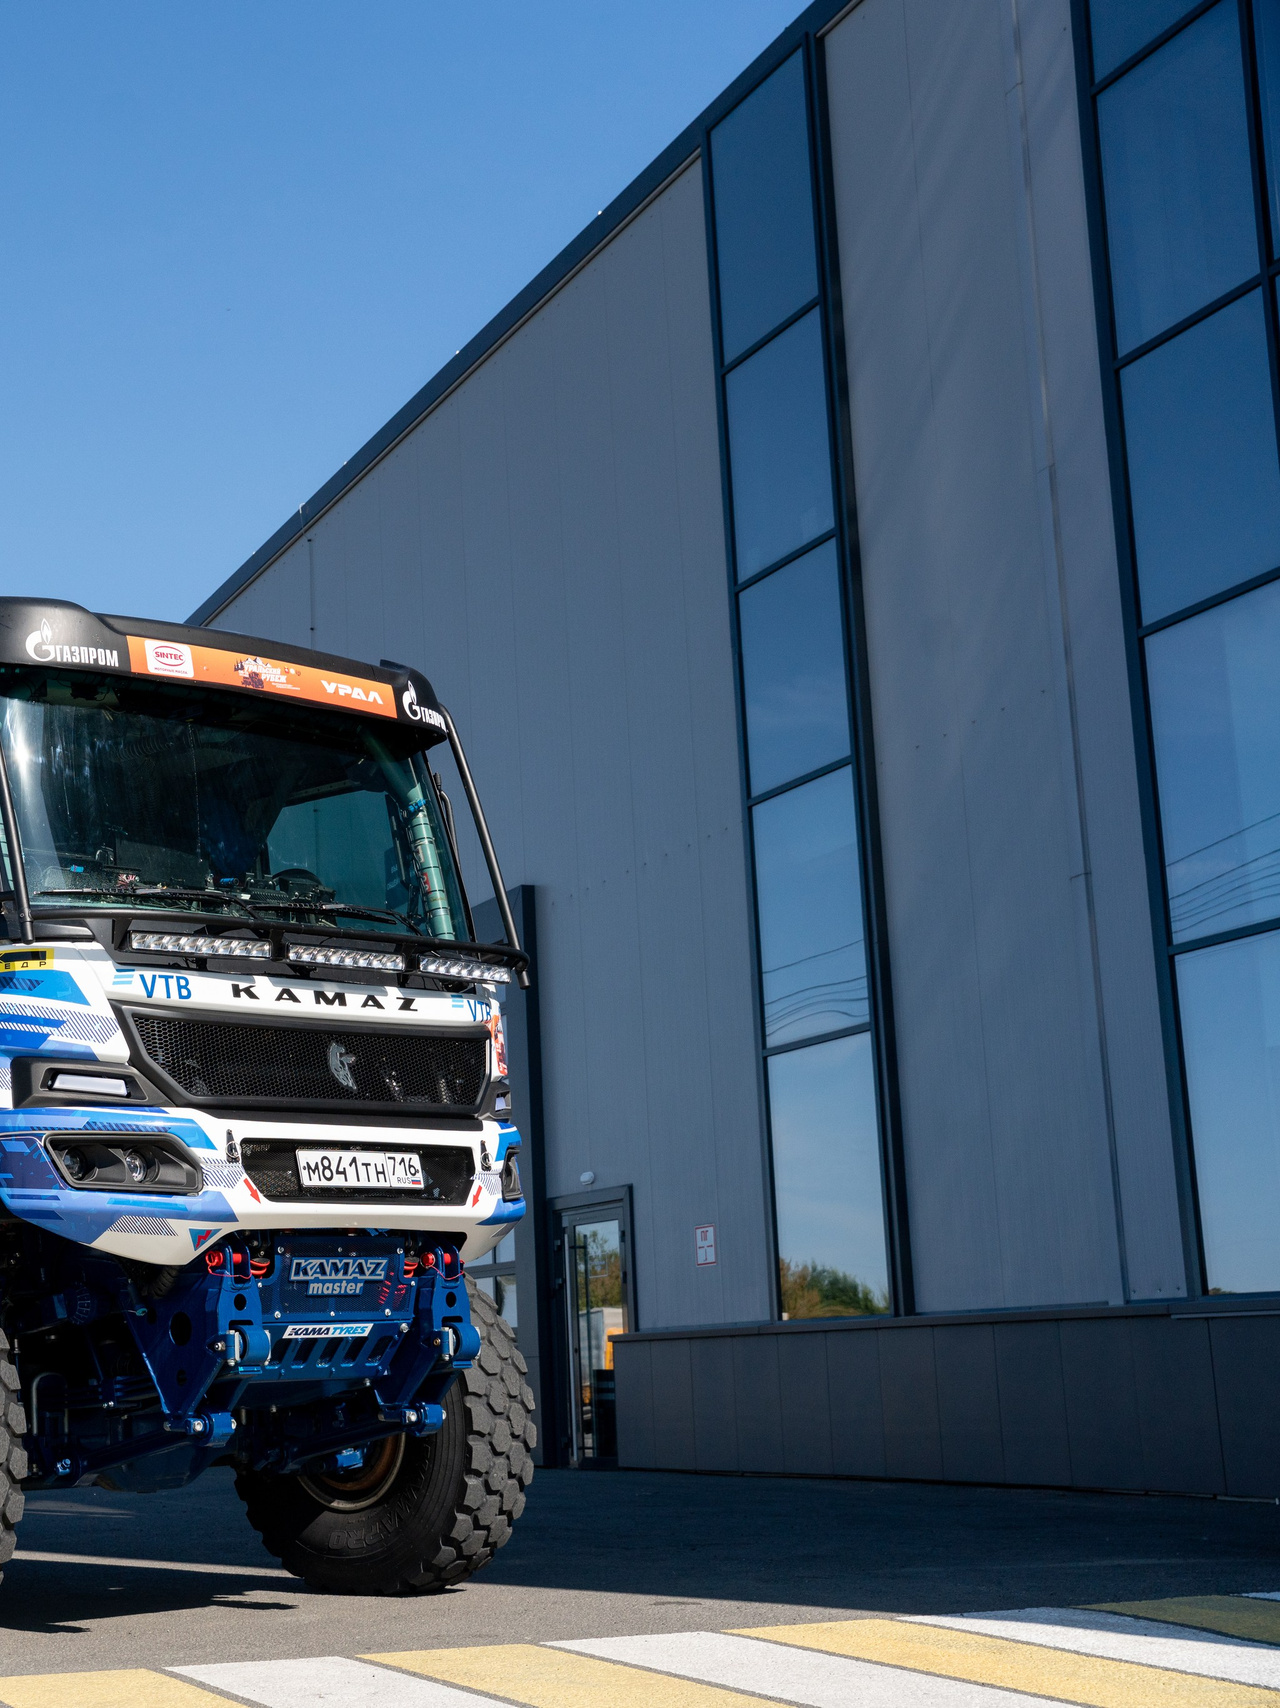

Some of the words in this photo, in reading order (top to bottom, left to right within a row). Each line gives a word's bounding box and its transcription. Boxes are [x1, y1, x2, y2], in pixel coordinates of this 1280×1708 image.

[55, 645, 119, 667] ГАЗПРОМ
[155, 650, 184, 662] SINTEC
[244, 663, 281, 675] УРАЛЬСКИЙ
[261, 673, 287, 683] РУБЕЖ
[320, 680, 384, 705] УРАЛ
[139, 974, 192, 1000] VTB
[231, 983, 418, 1012] KAMAZ
[305, 1155, 388, 1183] М841ТН
[387, 1156, 418, 1177] 716
[396, 1176, 412, 1185] RUS
[290, 1259, 389, 1280] KAMAZ
[308, 1280, 364, 1295] master
[288, 1326, 331, 1336] KAMA
[331, 1325, 369, 1335] TYRES
